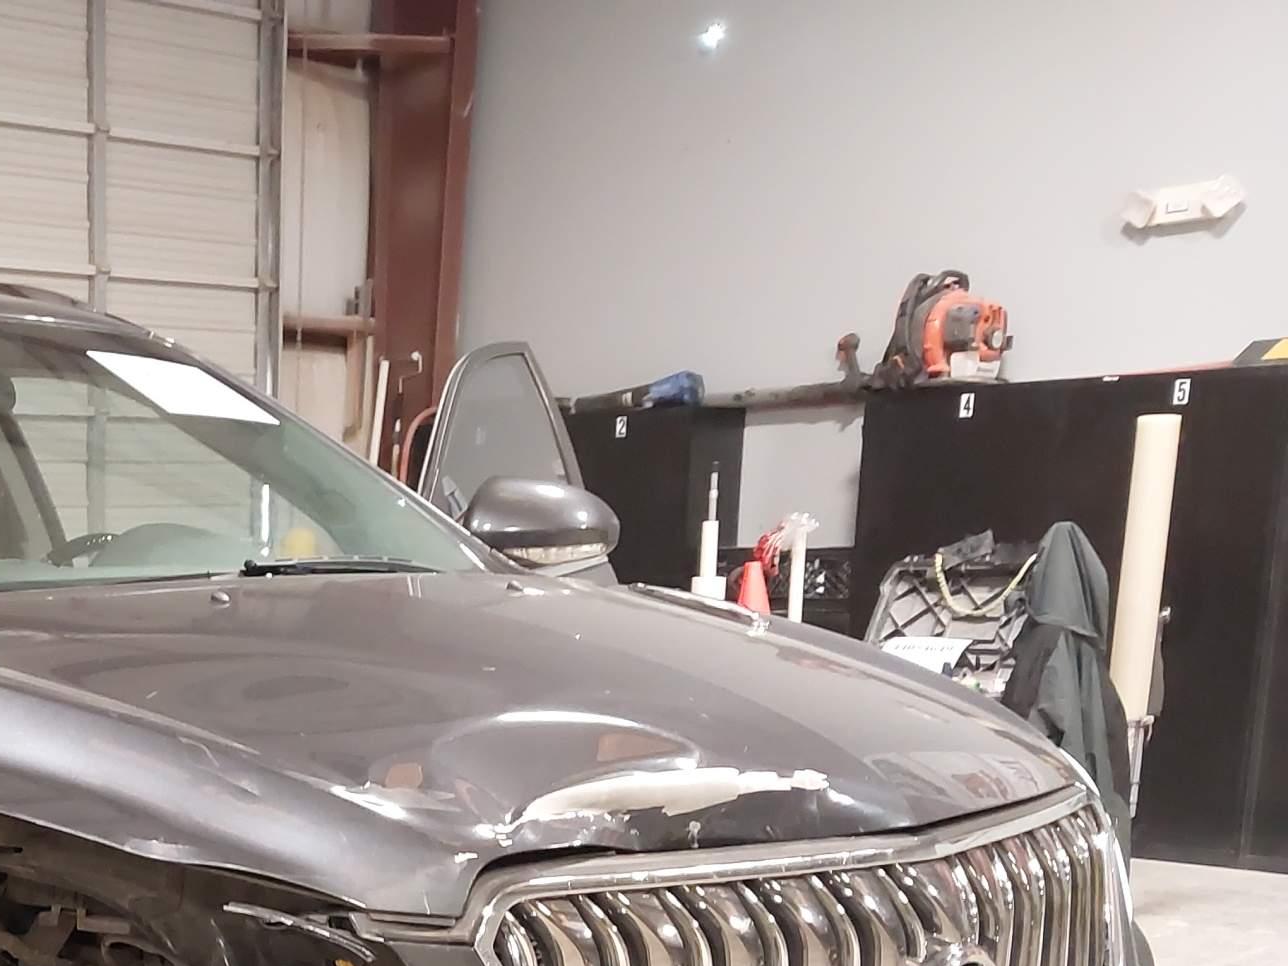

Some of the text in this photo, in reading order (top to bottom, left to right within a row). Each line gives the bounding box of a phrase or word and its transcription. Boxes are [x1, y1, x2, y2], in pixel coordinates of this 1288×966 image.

[1177, 381, 1187, 402] 5
[963, 394, 971, 416] 4
[618, 418, 626, 435] 2
